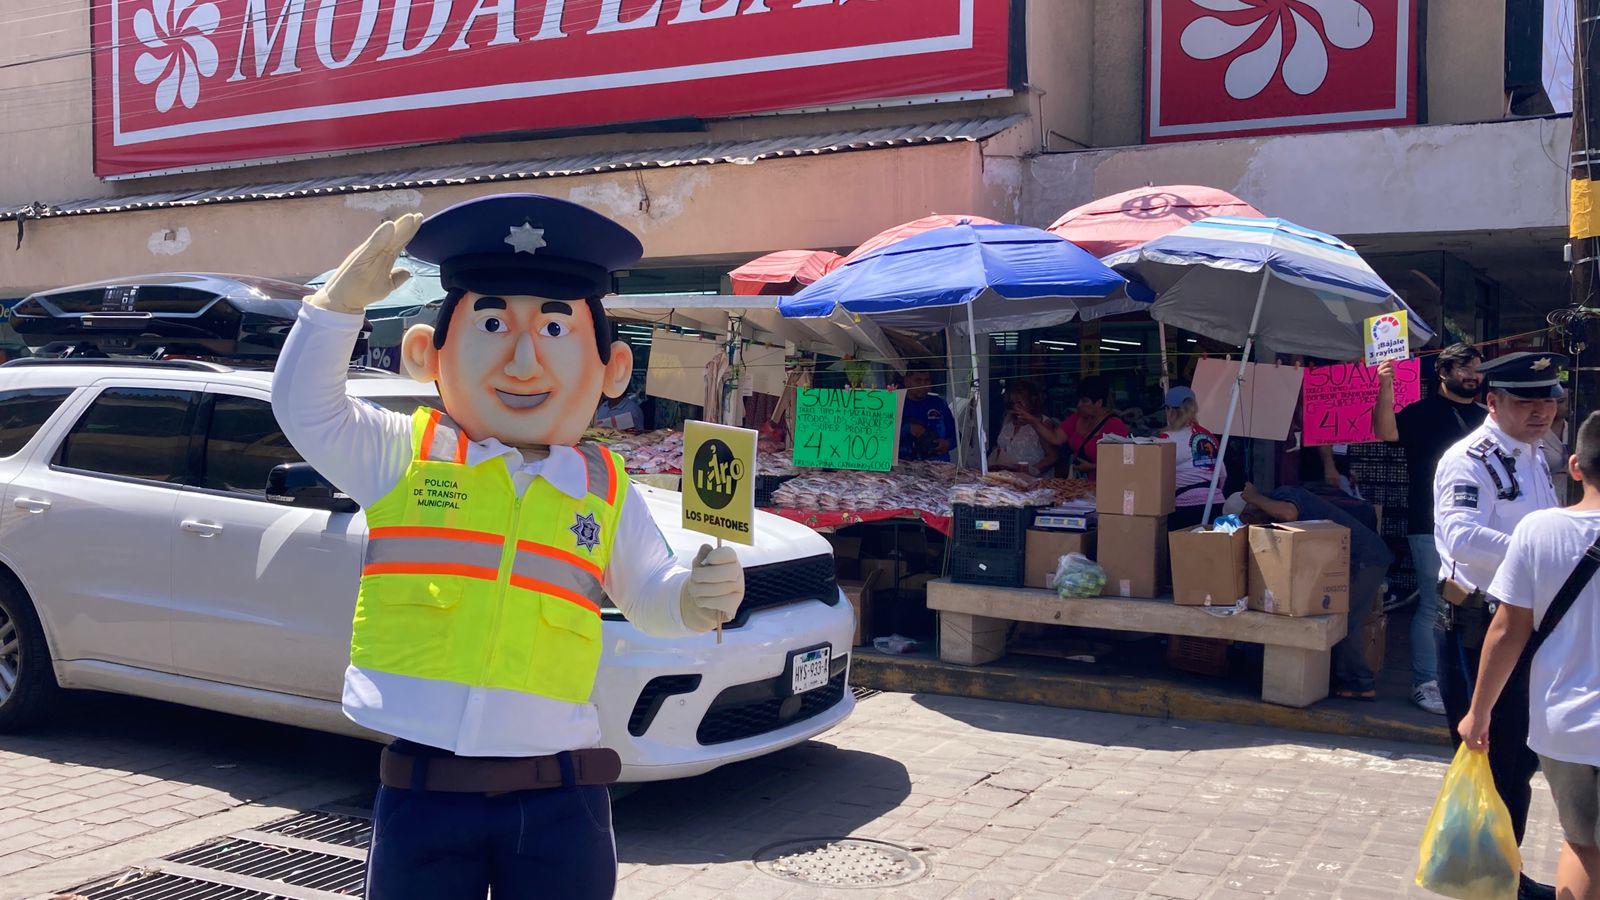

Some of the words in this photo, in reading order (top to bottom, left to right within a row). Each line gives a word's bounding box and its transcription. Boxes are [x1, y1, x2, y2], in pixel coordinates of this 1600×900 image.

[1376, 346, 1405, 356] rayitas!
[1309, 360, 1418, 387] SUAVS
[802, 388, 883, 410] SUAVES
[1320, 411, 1338, 437] 4
[804, 432, 822, 458] 4
[844, 434, 879, 460] 100
[414, 488, 424, 496] DE
[427, 489, 468, 501] TRANSITO
[424, 479, 458, 489] POLICIA
[417, 499, 460, 509] MUNICIPAL
[686, 509, 702, 521] LOS
[703, 513, 749, 533] PEATONES
